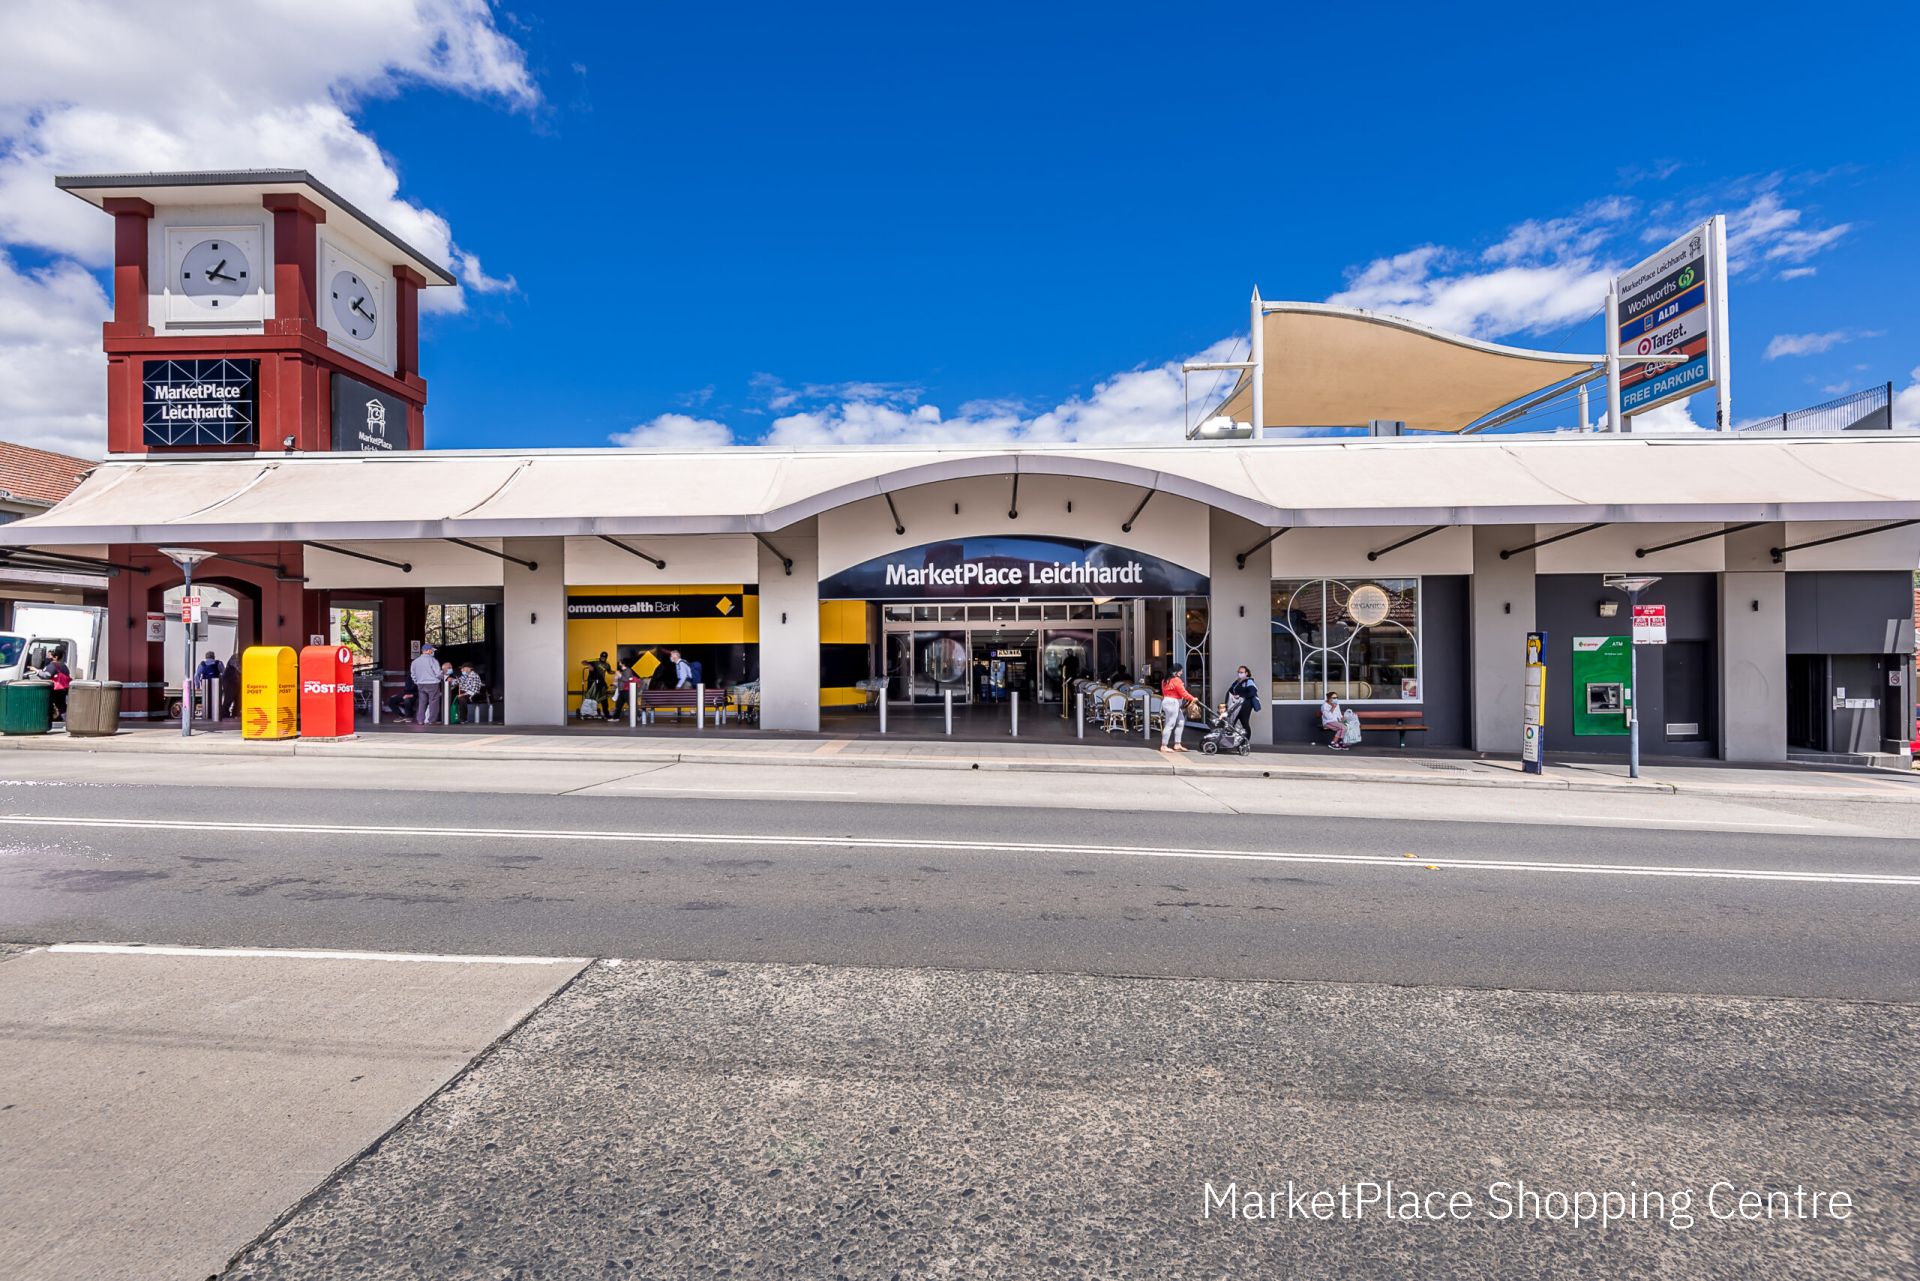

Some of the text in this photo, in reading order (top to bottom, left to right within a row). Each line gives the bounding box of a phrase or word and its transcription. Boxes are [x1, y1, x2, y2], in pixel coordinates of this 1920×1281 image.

[1621, 250, 1687, 294] MarketPlace Leichhardt
[1628, 278, 1677, 315] Woolworths
[1657, 302, 1679, 322] ALDI
[155, 384, 240, 400] MarketPlace
[1623, 386, 1651, 408] FREE
[1653, 364, 1704, 395] PARKING
[161, 404, 233, 420] Leichhardt
[358, 431, 393, 449] MarketPlace
[885, 561, 1143, 586] MarketPlace Leichhardt
[568, 601, 680, 613] ommonwealth Bank
[304, 684, 336, 693] POST
[337, 685, 354, 693] POST
